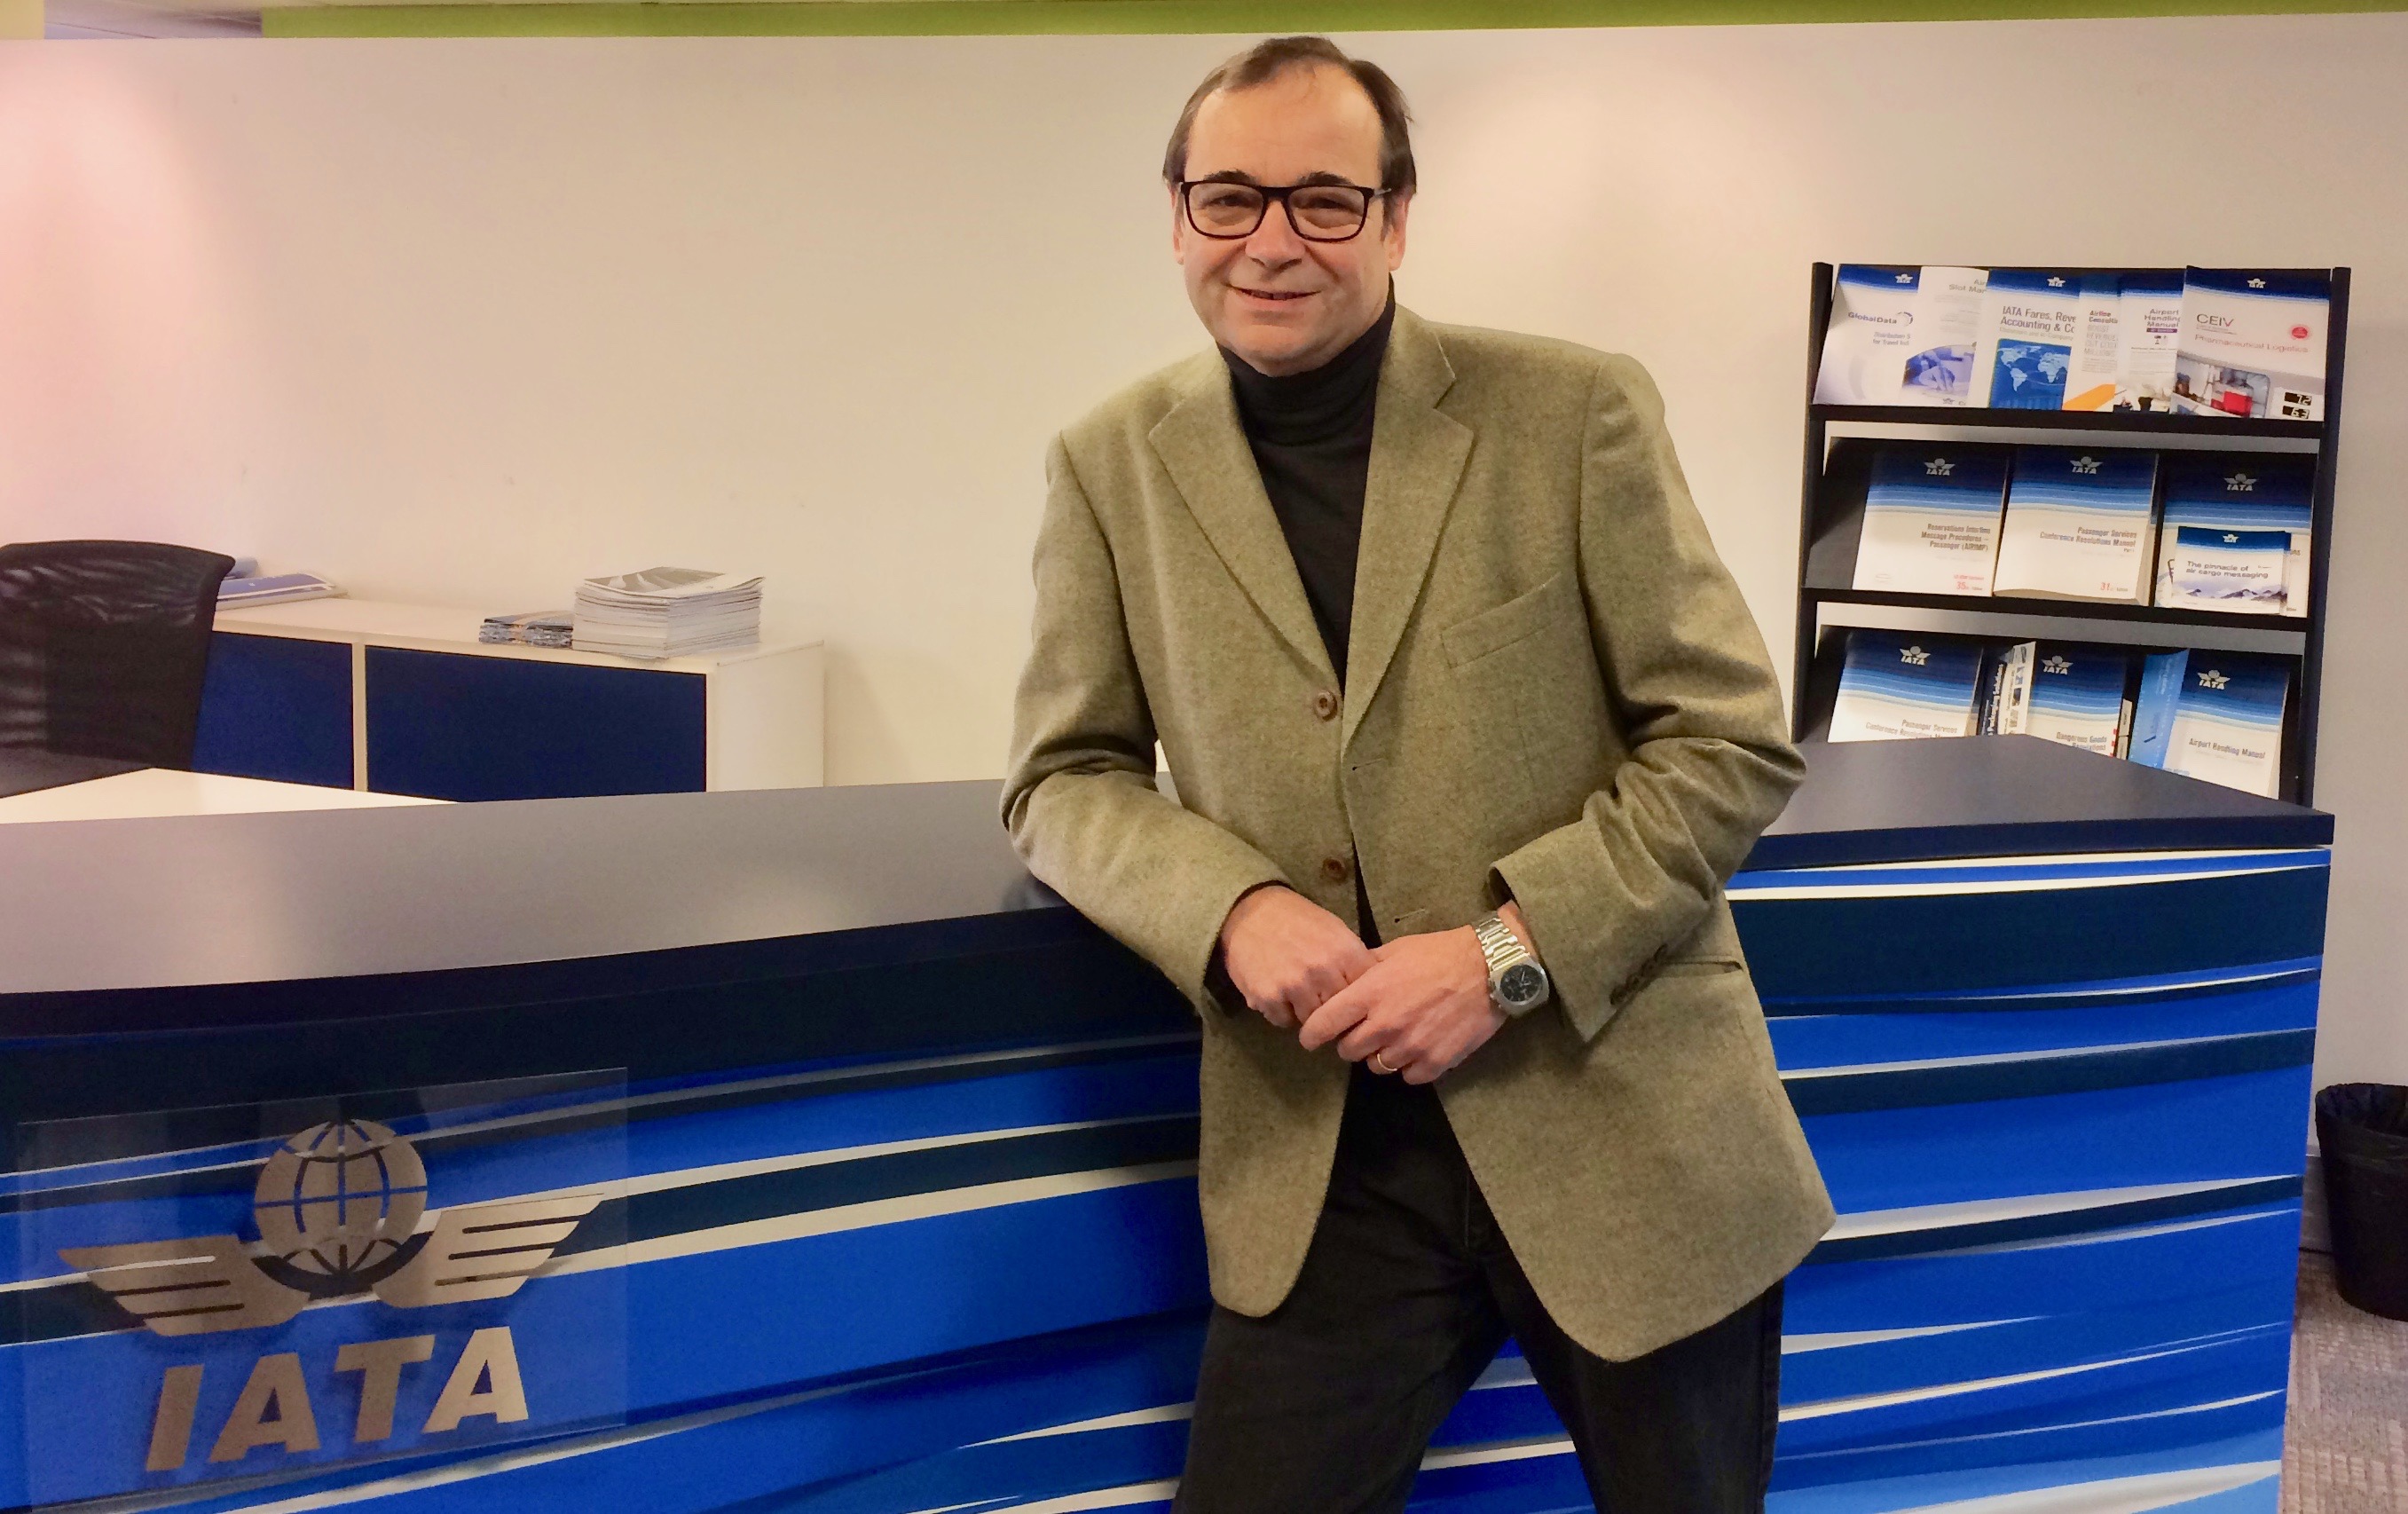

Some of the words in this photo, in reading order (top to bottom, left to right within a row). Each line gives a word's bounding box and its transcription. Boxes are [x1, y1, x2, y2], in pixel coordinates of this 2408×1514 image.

[1848, 311, 1898, 325] GlobalData
[2003, 305, 2022, 318] IATA
[2025, 308, 2053, 321] Fares,
[2000, 316, 2051, 332] Accounting
[2053, 323, 2061, 332] &
[2196, 313, 2235, 327] CEIV
[2224, 571, 2269, 580] messaging
[1900, 656, 1925, 666] IATA
[2043, 666, 2067, 675] IATA
[2199, 679, 2225, 690] IATA
[2189, 737, 2212, 748] Airport
[145, 1325, 530, 1472] IATA
